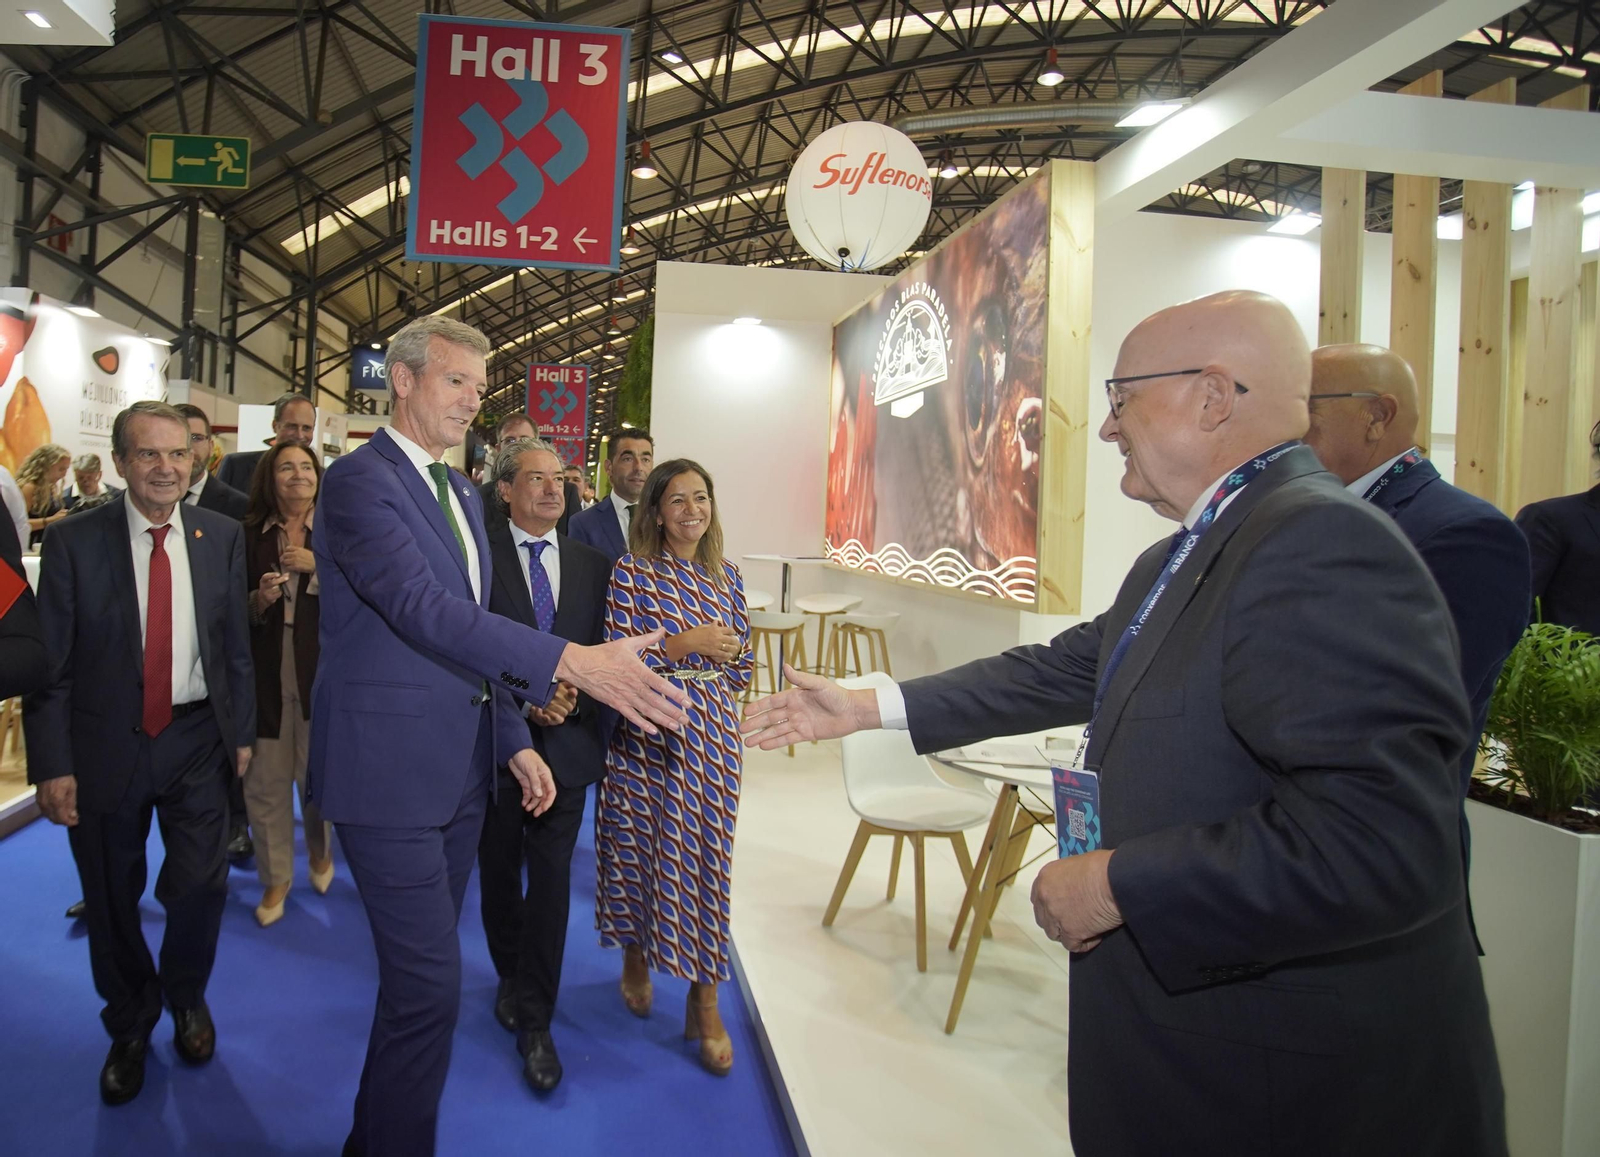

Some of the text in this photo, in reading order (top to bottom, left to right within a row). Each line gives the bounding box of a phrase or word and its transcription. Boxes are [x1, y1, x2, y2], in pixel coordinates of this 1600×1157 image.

[450, 34, 609, 86] Hall 3
[429, 219, 559, 251] Halls 1-2
[901, 282, 920, 304] BLAS
[921, 282, 953, 352] PARADELA
[535, 367, 584, 384] Hall 3
[537, 424, 570, 434] alls 1-2
[1171, 534, 1200, 572] ABANCA
